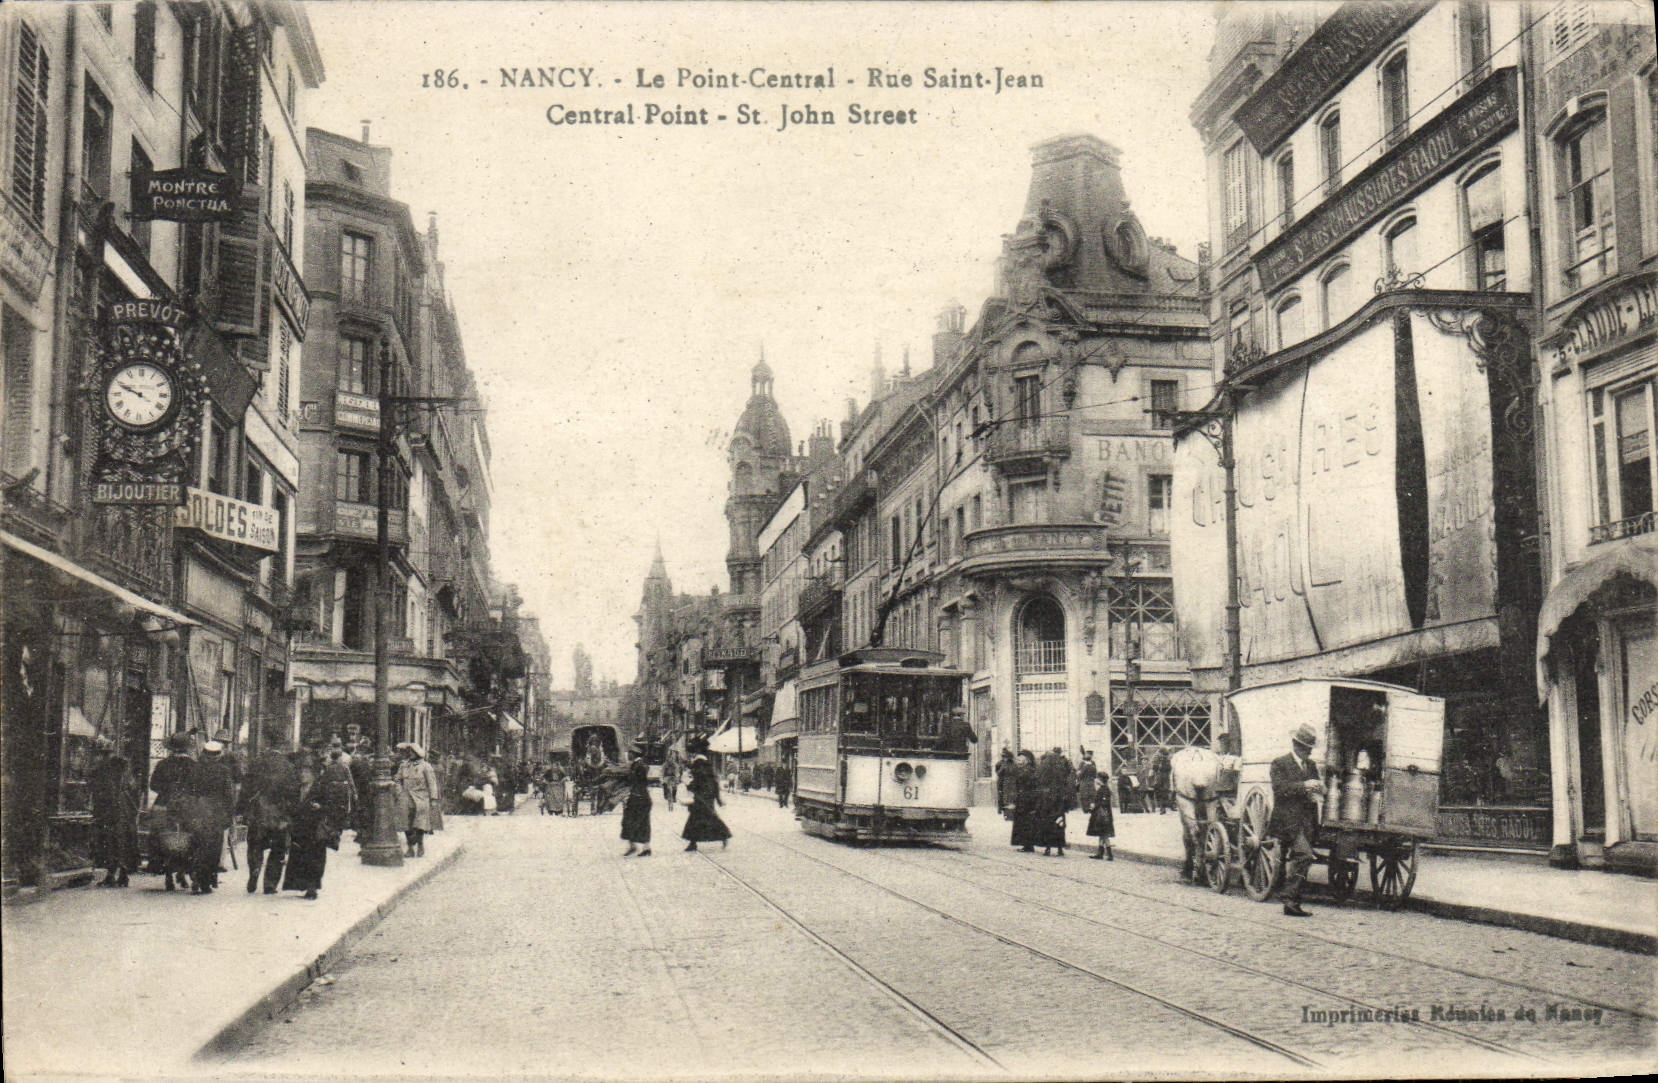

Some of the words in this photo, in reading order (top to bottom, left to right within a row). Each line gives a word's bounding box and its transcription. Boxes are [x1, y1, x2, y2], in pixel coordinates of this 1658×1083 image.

[147, 179, 220, 196] MONTRE
[1330, 160, 1408, 239] CHAUSSURES
[1408, 126, 1460, 180] RAOUL
[113, 303, 186, 323] PREVOT
[97, 483, 181, 501] BIJOUTIER
[903, 785, 920, 800] 61
